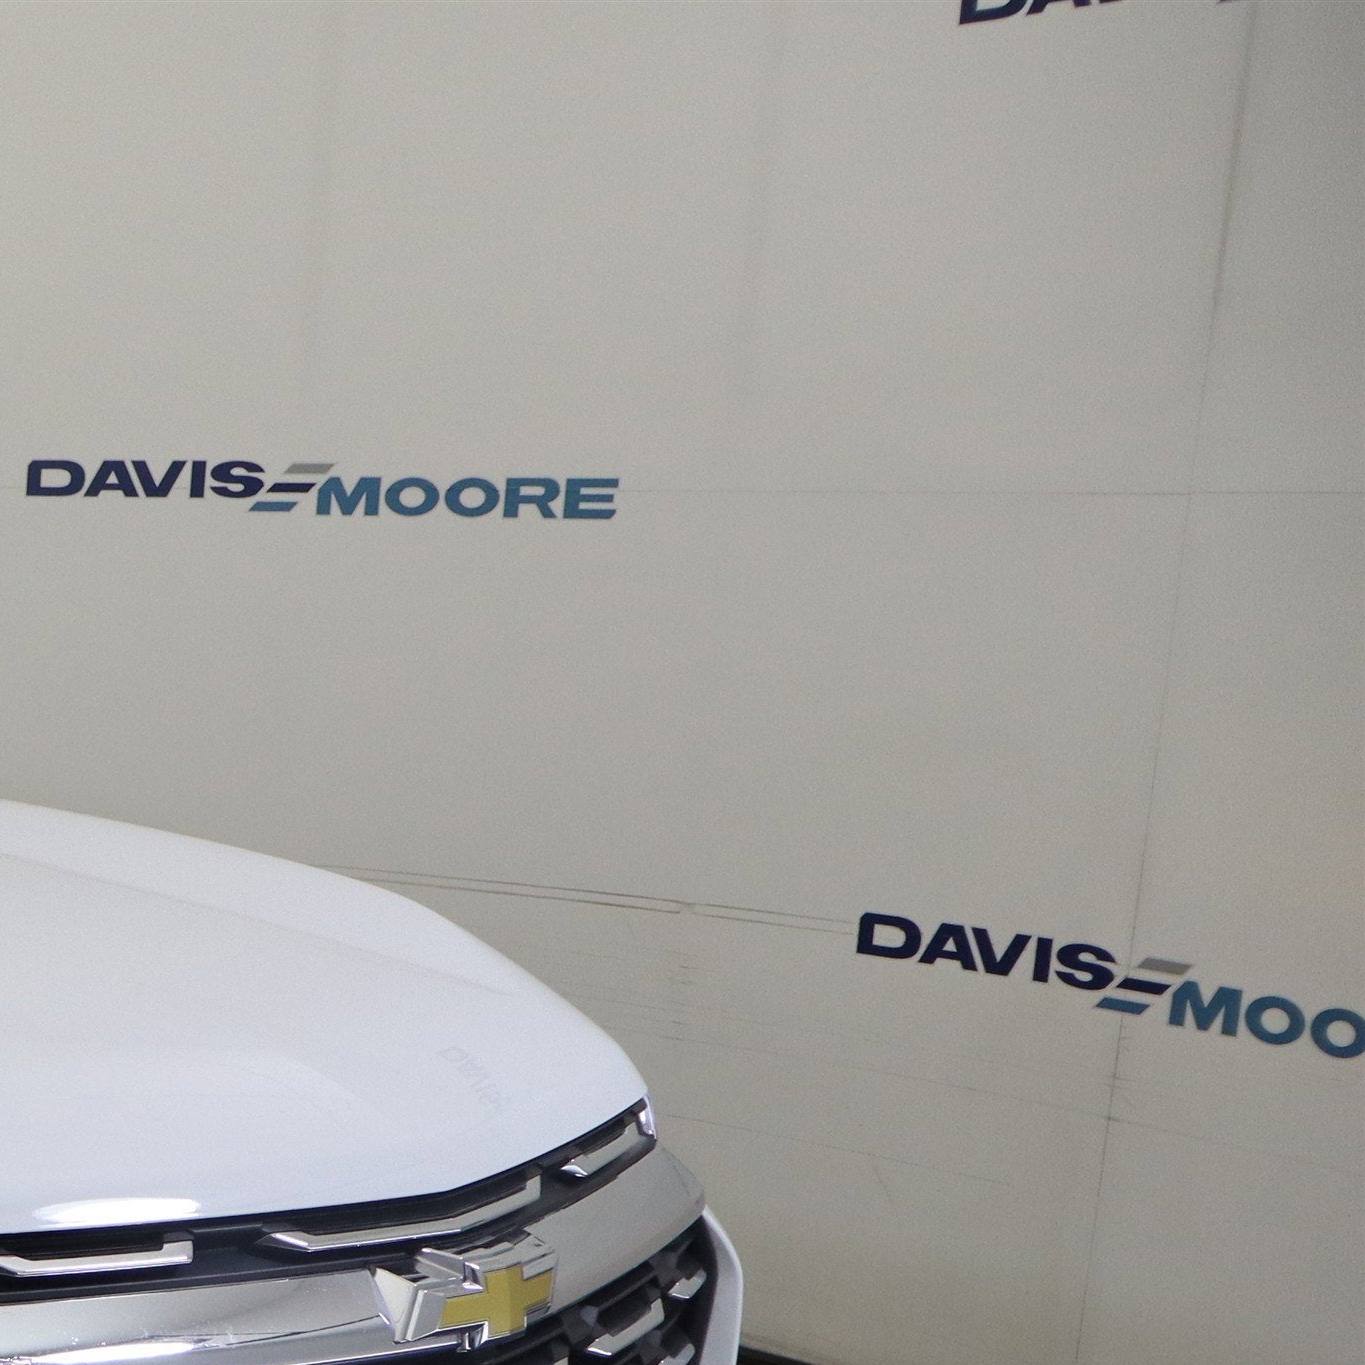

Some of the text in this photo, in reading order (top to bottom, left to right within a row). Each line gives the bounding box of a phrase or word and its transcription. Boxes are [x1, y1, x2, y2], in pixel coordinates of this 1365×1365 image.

[25, 459, 620, 519] DAVIS MOORE
[856, 912, 1365, 1059] DAVIS MOO
